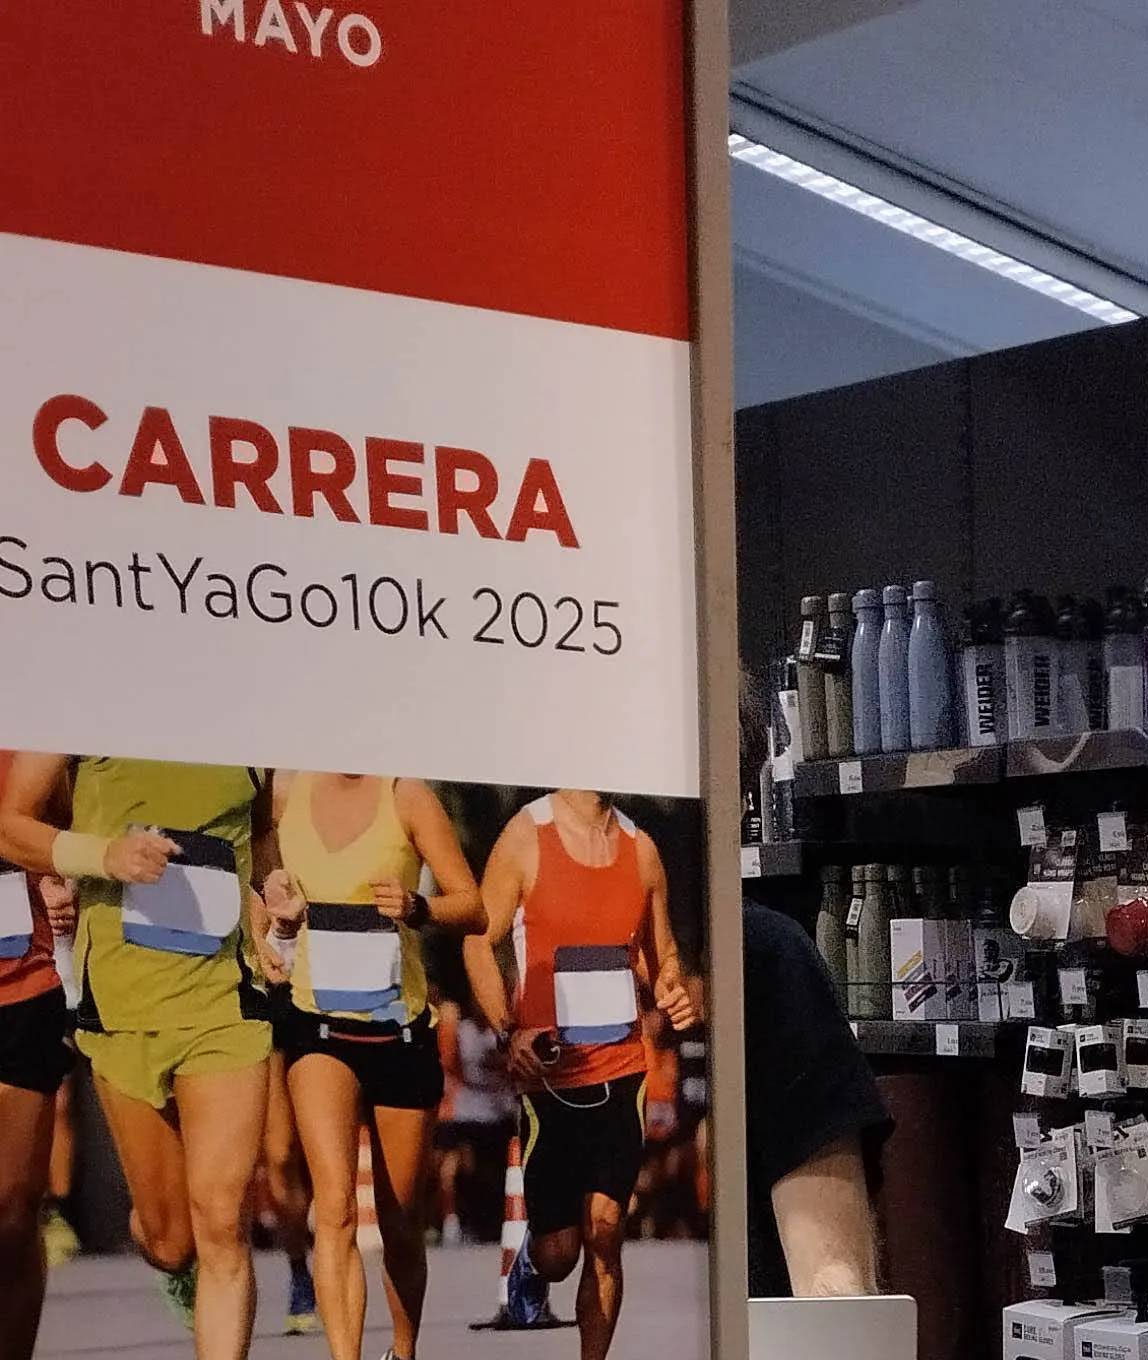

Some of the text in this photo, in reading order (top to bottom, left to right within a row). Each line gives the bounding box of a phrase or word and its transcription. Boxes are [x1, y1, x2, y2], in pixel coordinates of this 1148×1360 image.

[200, 0, 382, 67] MAYO
[33, 393, 581, 549] CARRERA
[473, 588, 622, 655] 2025
